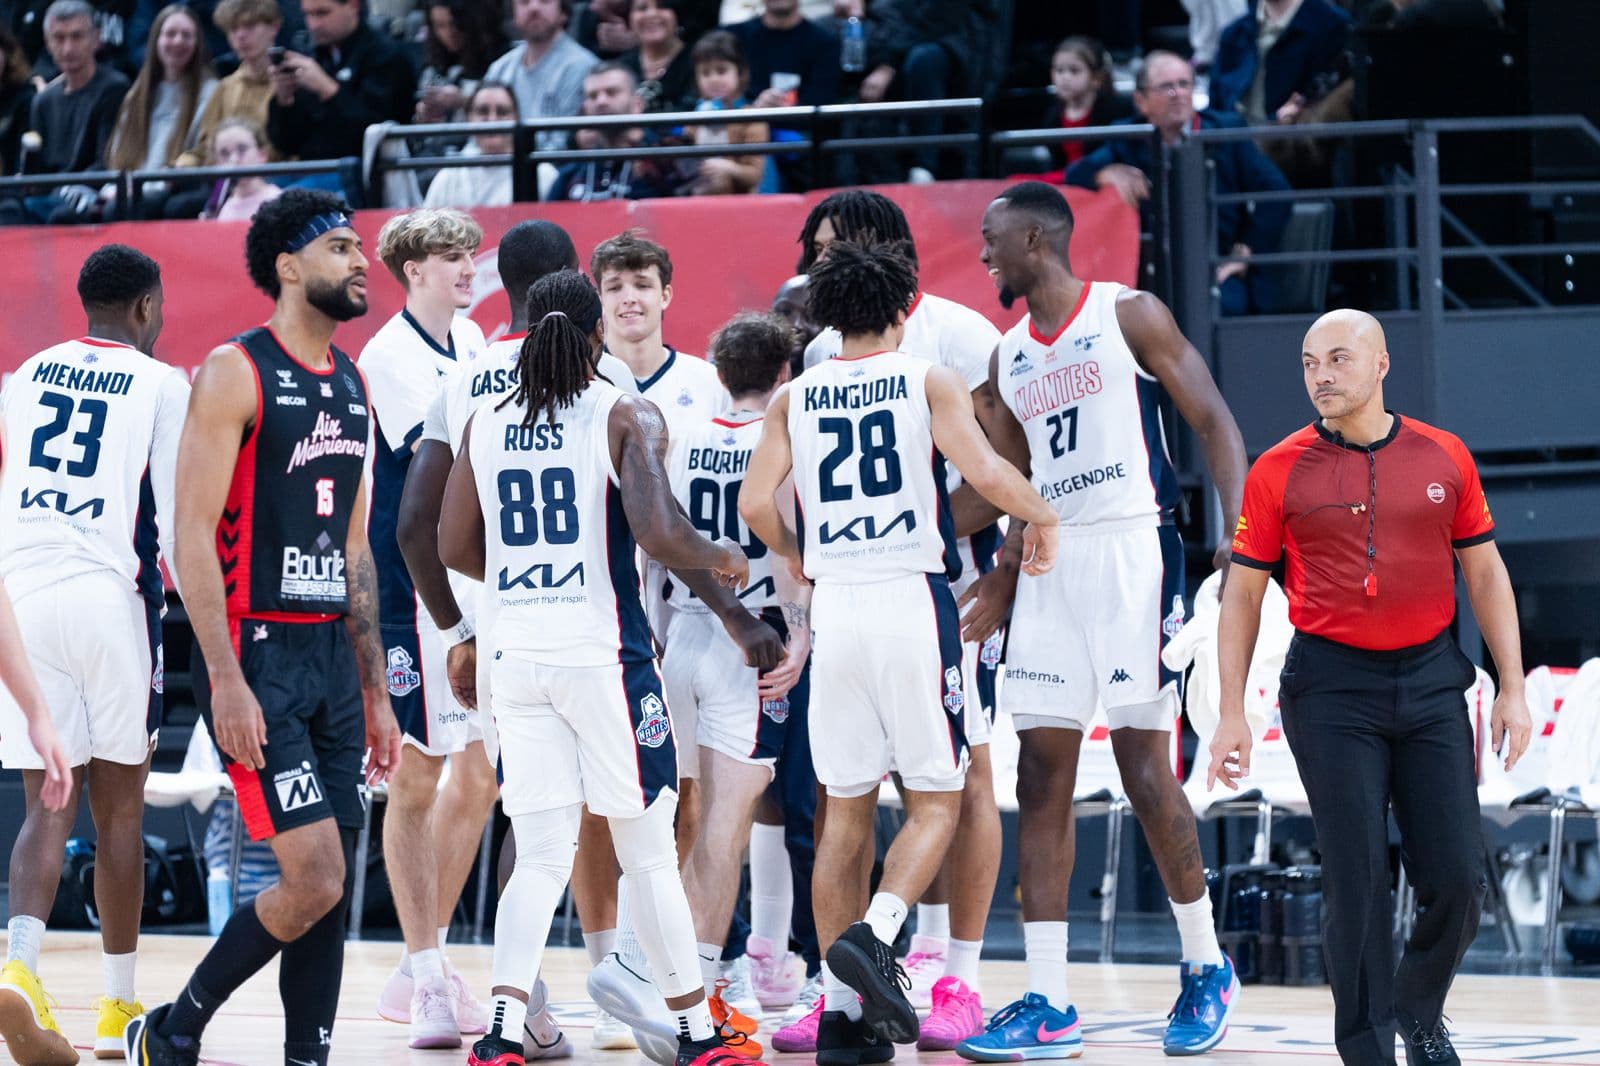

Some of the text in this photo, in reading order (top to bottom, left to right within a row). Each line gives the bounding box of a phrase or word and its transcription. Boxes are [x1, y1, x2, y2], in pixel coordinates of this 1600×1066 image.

[32, 361, 134, 396] MIENANDI
[805, 375, 908, 412] KANGUDIA
[1014, 360, 1103, 422] NANTES
[29, 390, 109, 479] 23
[312, 411, 342, 443] Aix
[504, 423, 564, 451] ROSS
[1046, 406, 1079, 459] 27
[286, 437, 366, 474] Maurienne
[819, 410, 903, 503] 28
[315, 478, 335, 517] 15
[1050, 462, 1126, 500] LEGENDRE
[20, 487, 105, 520] KIA
[497, 467, 580, 547] 88
[819, 509, 917, 545] KIA
[821, 541, 921, 560] Movement that inspires
[498, 561, 584, 591] KIA
[541, 594, 559, 604] that
[638, 719, 669, 741] NANTES
